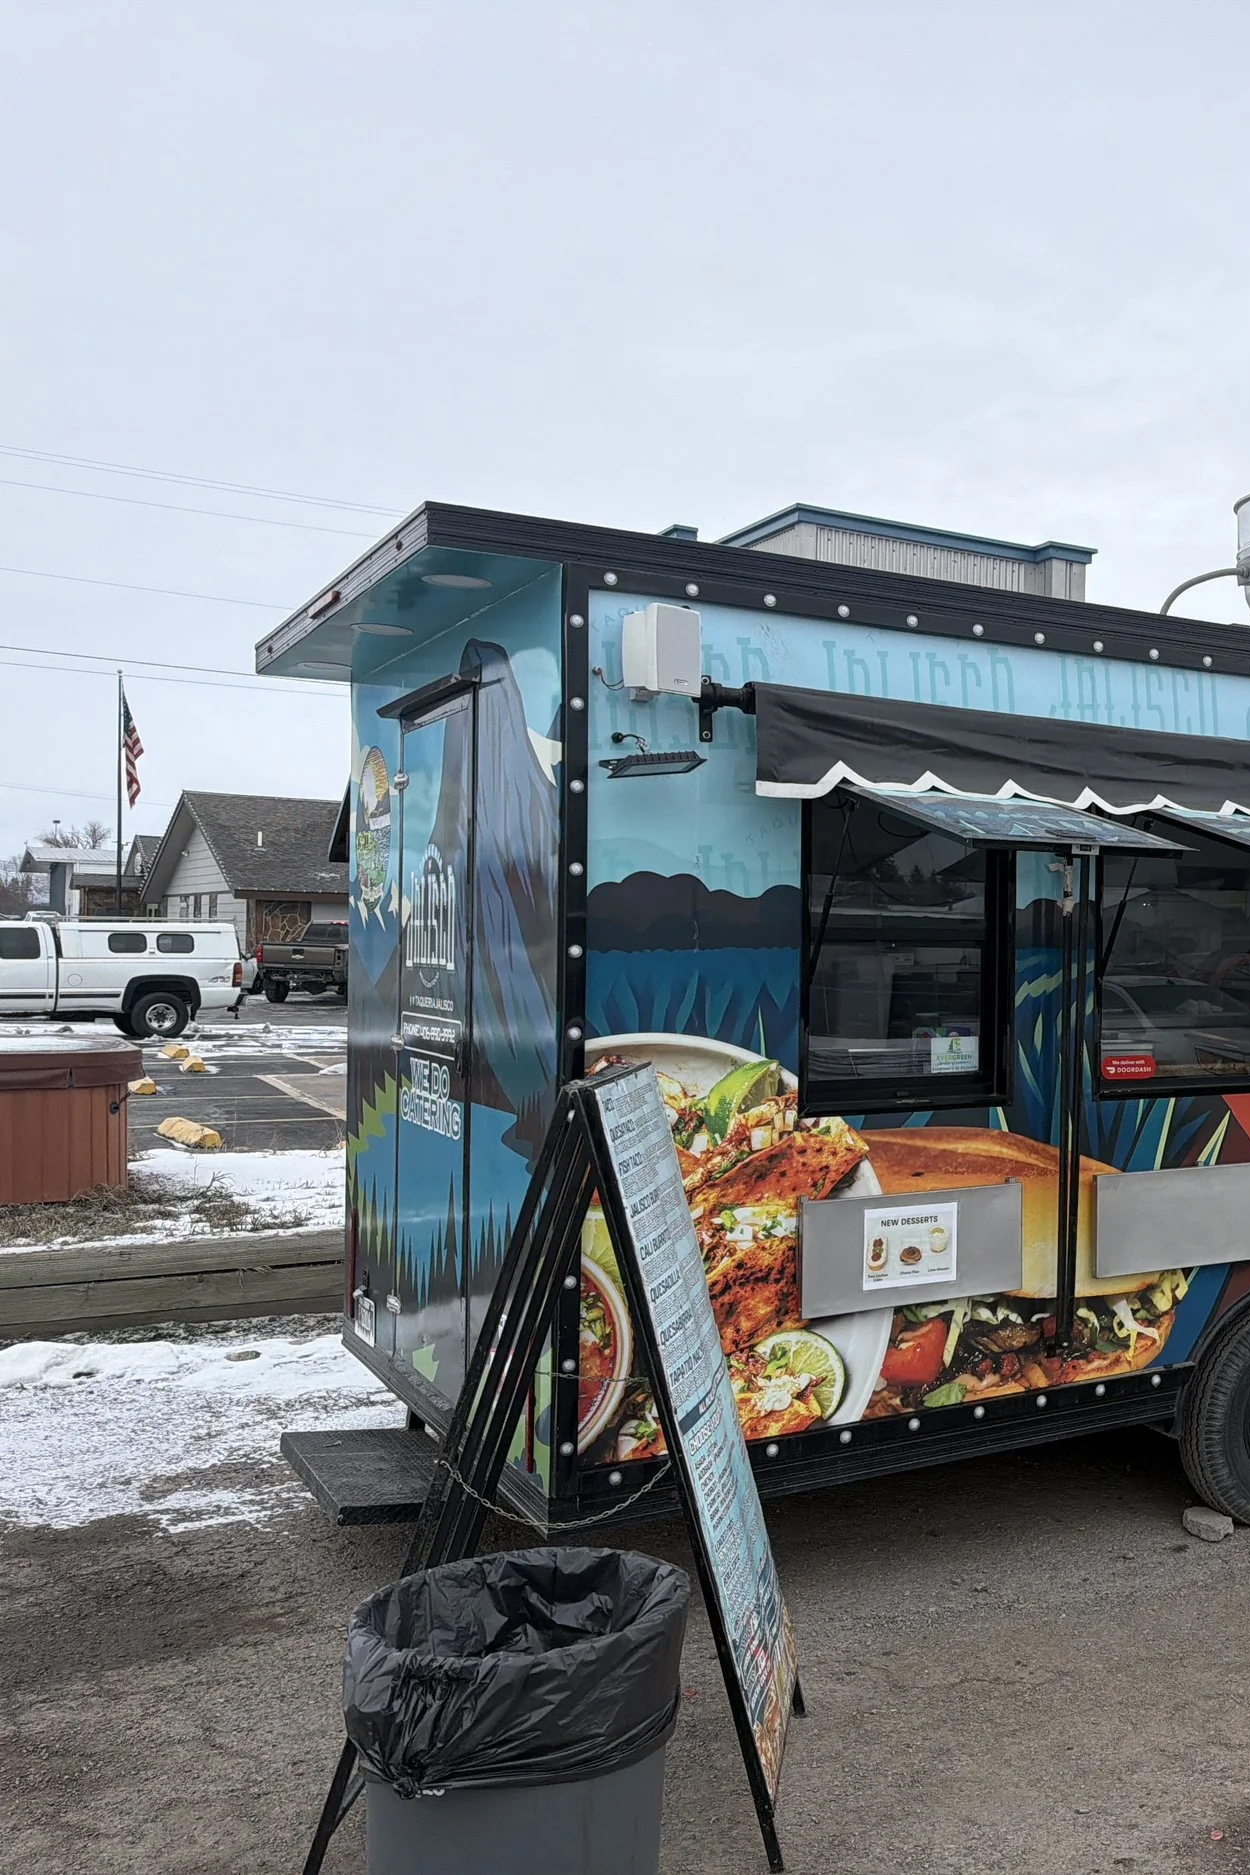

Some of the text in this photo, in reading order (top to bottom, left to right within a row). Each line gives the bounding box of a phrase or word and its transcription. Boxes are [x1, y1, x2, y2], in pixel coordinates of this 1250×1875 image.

[410, 1057, 450, 1101] WE DO
[400, 1086, 461, 1141] CATERING
[880, 1215, 938, 1227] NEW DESSERTS
